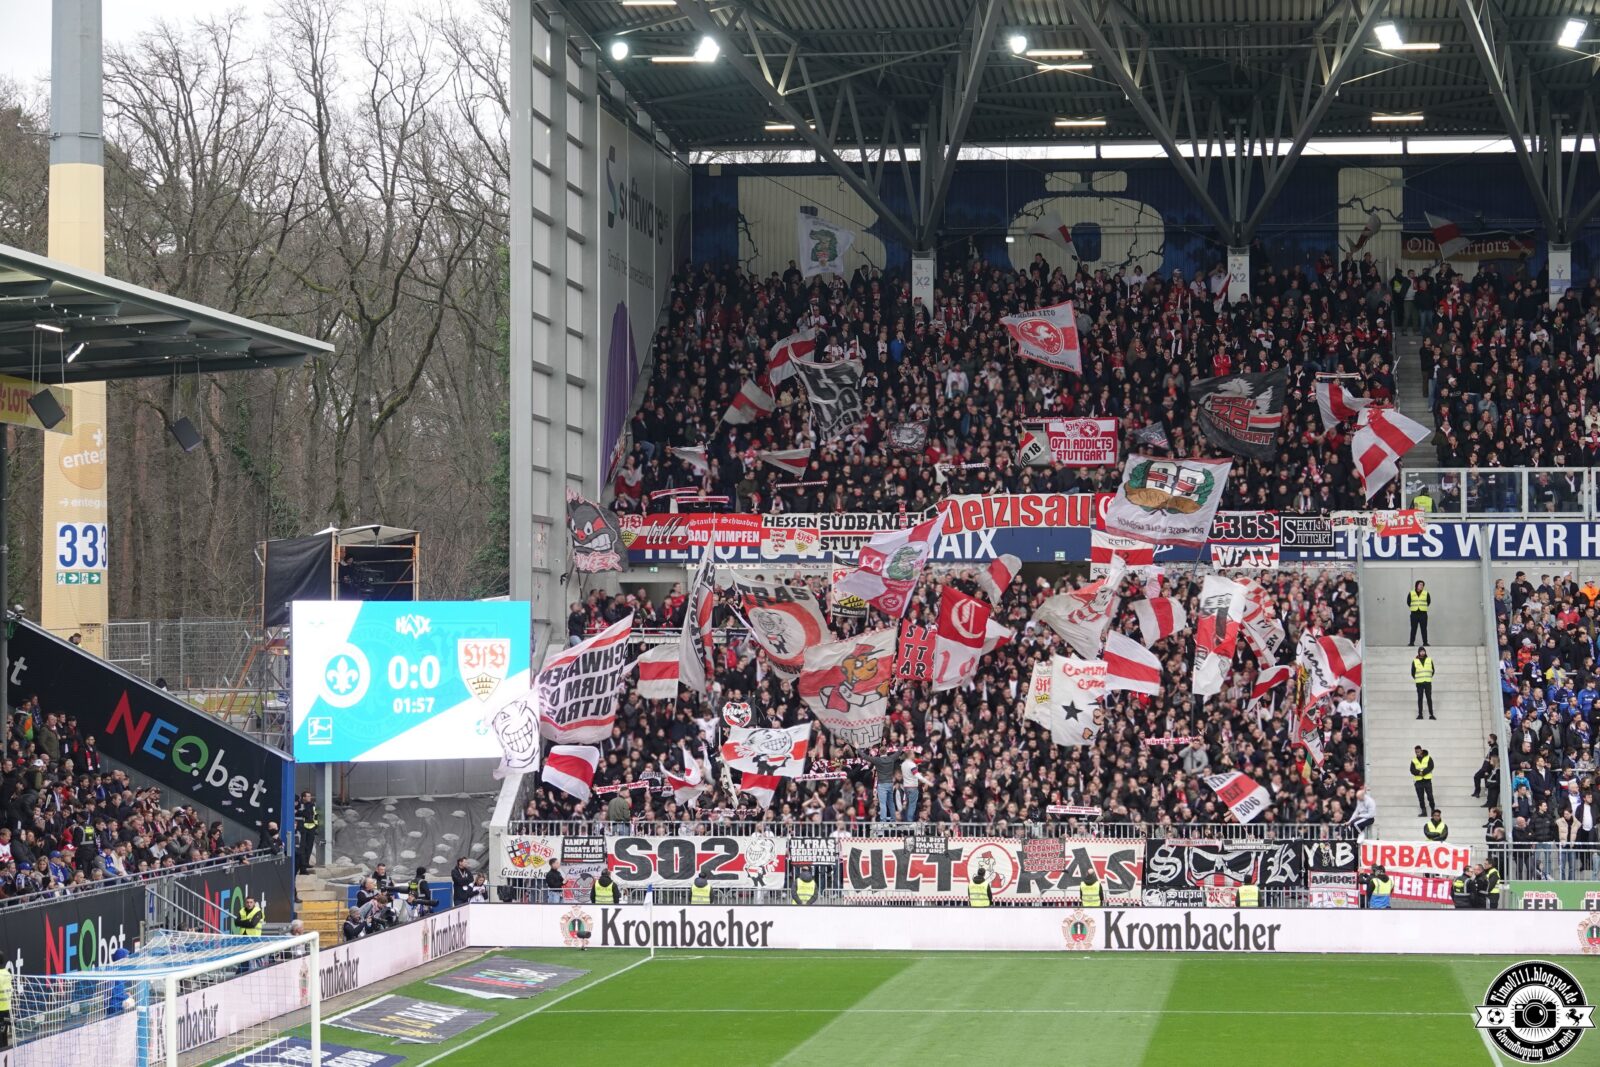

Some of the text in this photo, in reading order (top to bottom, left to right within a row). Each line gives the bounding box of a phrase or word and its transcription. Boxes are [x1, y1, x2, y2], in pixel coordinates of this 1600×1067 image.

[1052, 438, 1112, 450] 0711 ADDICTS
[1056, 450, 1107, 461] STUTTGART
[764, 516, 817, 528] HESSEN
[943, 494, 1090, 535] Deizisau
[689, 529, 760, 543] BAD WIMPFEN
[934, 529, 998, 560] AIX
[1454, 524, 1568, 558] WEAR
[464, 643, 507, 670] VfB
[387, 654, 441, 690] 0:0
[393, 696, 435, 713] 01:57
[1235, 796, 1261, 817] 2006
[564, 838, 587, 846] KAMPF
[791, 838, 835, 849] ULTRAS
[791, 848, 835, 856] BEDEUTET
[1361, 844, 1469, 871] URBACH
[431, 911, 468, 959] Krombacher
[600, 908, 774, 947] Krombacher
[1105, 911, 1281, 951] Krombacher
[319, 947, 360, 998] rombacher
